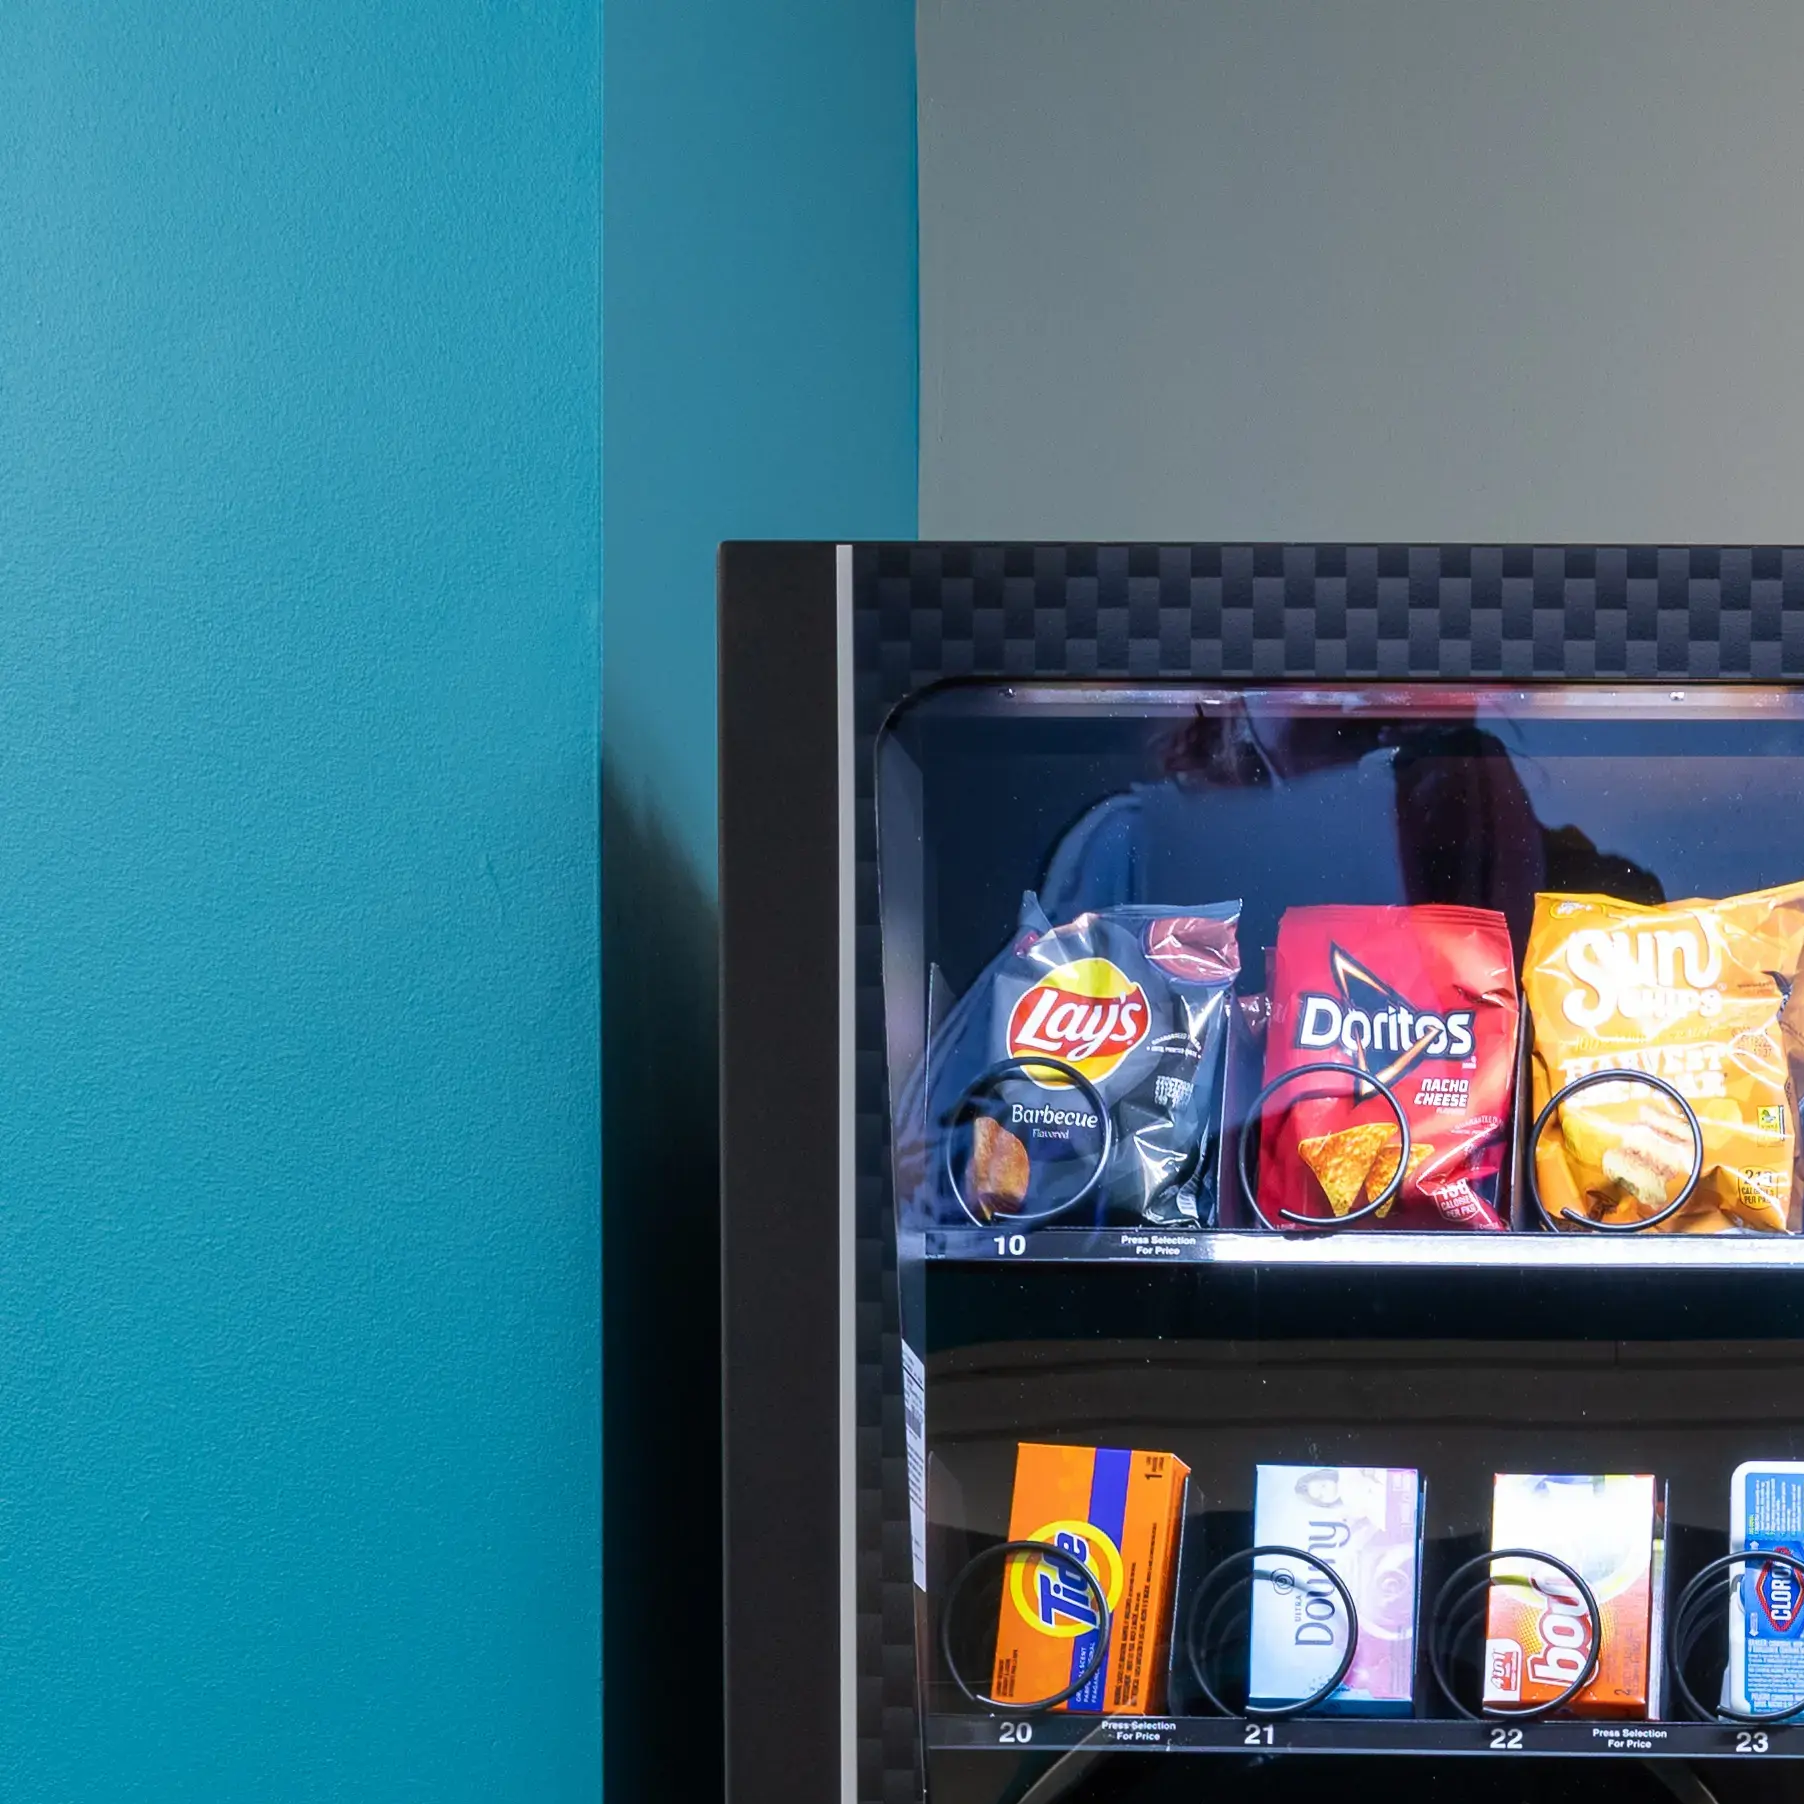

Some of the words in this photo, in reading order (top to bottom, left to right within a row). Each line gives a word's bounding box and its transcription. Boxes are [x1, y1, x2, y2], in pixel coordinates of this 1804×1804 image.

[1015, 988, 1143, 1062] Lay's
[1300, 996, 1473, 1056] Doritos
[1421, 1078, 1469, 1093] NACHO
[1414, 1093, 1469, 1108] CHEESE
[1012, 1104, 1099, 1129] Barbecue
[993, 1233, 1027, 1256] 10
[1121, 1235, 1150, 1245] Press
[1150, 1235, 1197, 1245] Selection
[1136, 1246, 1152, 1255] For
[1153, 1246, 1181, 1256] Price
[1037, 1530, 1101, 1630] Tide
[1294, 1521, 1351, 1647] Downy
[999, 1722, 1033, 1744] 20
[1101, 1721, 1129, 1732] Press
[1131, 1721, 1176, 1732] Selection
[1116, 1732, 1133, 1741] For
[1134, 1732, 1161, 1741] Price
[1244, 1724, 1275, 1745] 21
[1592, 1728, 1620, 1739] Press
[1622, 1728, 1668, 1739] Selection
[1489, 1728, 1523, 1750] 22
[1607, 1739, 1624, 1749] For
[1625, 1739, 1652, 1749] Price
[1735, 1732, 1769, 1753] 23
